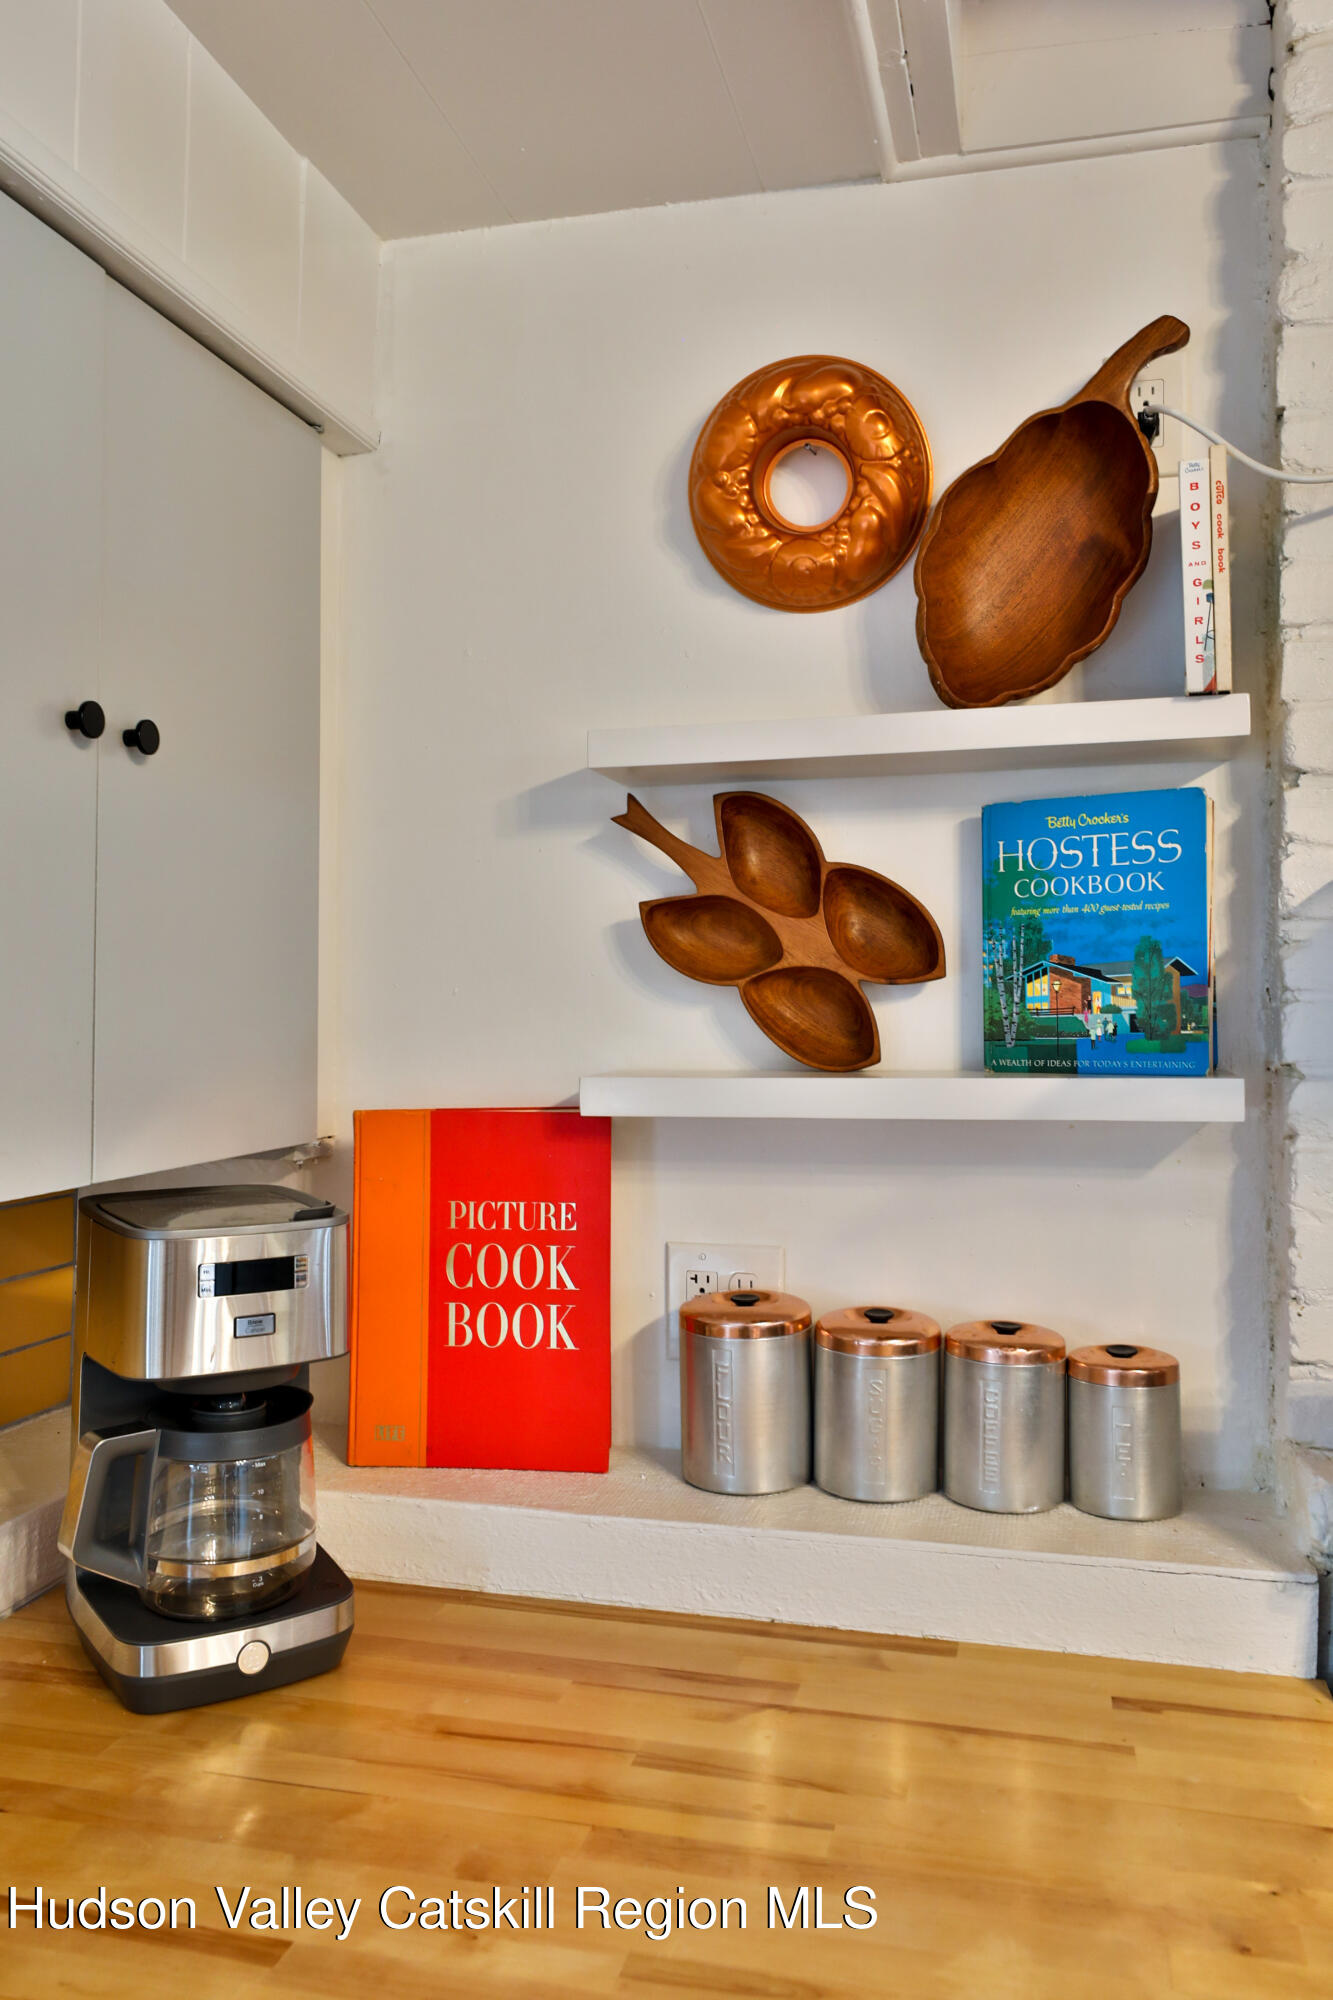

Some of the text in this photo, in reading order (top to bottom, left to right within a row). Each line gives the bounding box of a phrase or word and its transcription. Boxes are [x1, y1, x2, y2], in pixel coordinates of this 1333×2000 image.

[1189, 481, 1201, 550] BOYS
[1216, 514, 1225, 540] cook
[1217, 548, 1226, 574] book
[1192, 578, 1204, 664] GIRLS
[1045, 812, 1130, 829] Betty Crocker's
[997, 828, 1183, 873] HOSTESS
[1013, 871, 1166, 898] COOKBOOK
[1043, 906, 1060, 915] more
[1062, 904, 1079, 914] than
[1081, 903, 1100, 914] 400
[1144, 902, 1171, 912] recipes
[991, 1059, 998, 1067] A
[999, 1058, 1032, 1067] WEALTH
[1033, 1059, 1045, 1067] OF
[1047, 1059, 1072, 1067] IDEAS
[1131, 1060, 1197, 1069] ENTERTAINING
[448, 1200, 578, 1232] PICTURE
[445, 1242, 580, 1291] COOK
[444, 1302, 580, 1351] BOOK
